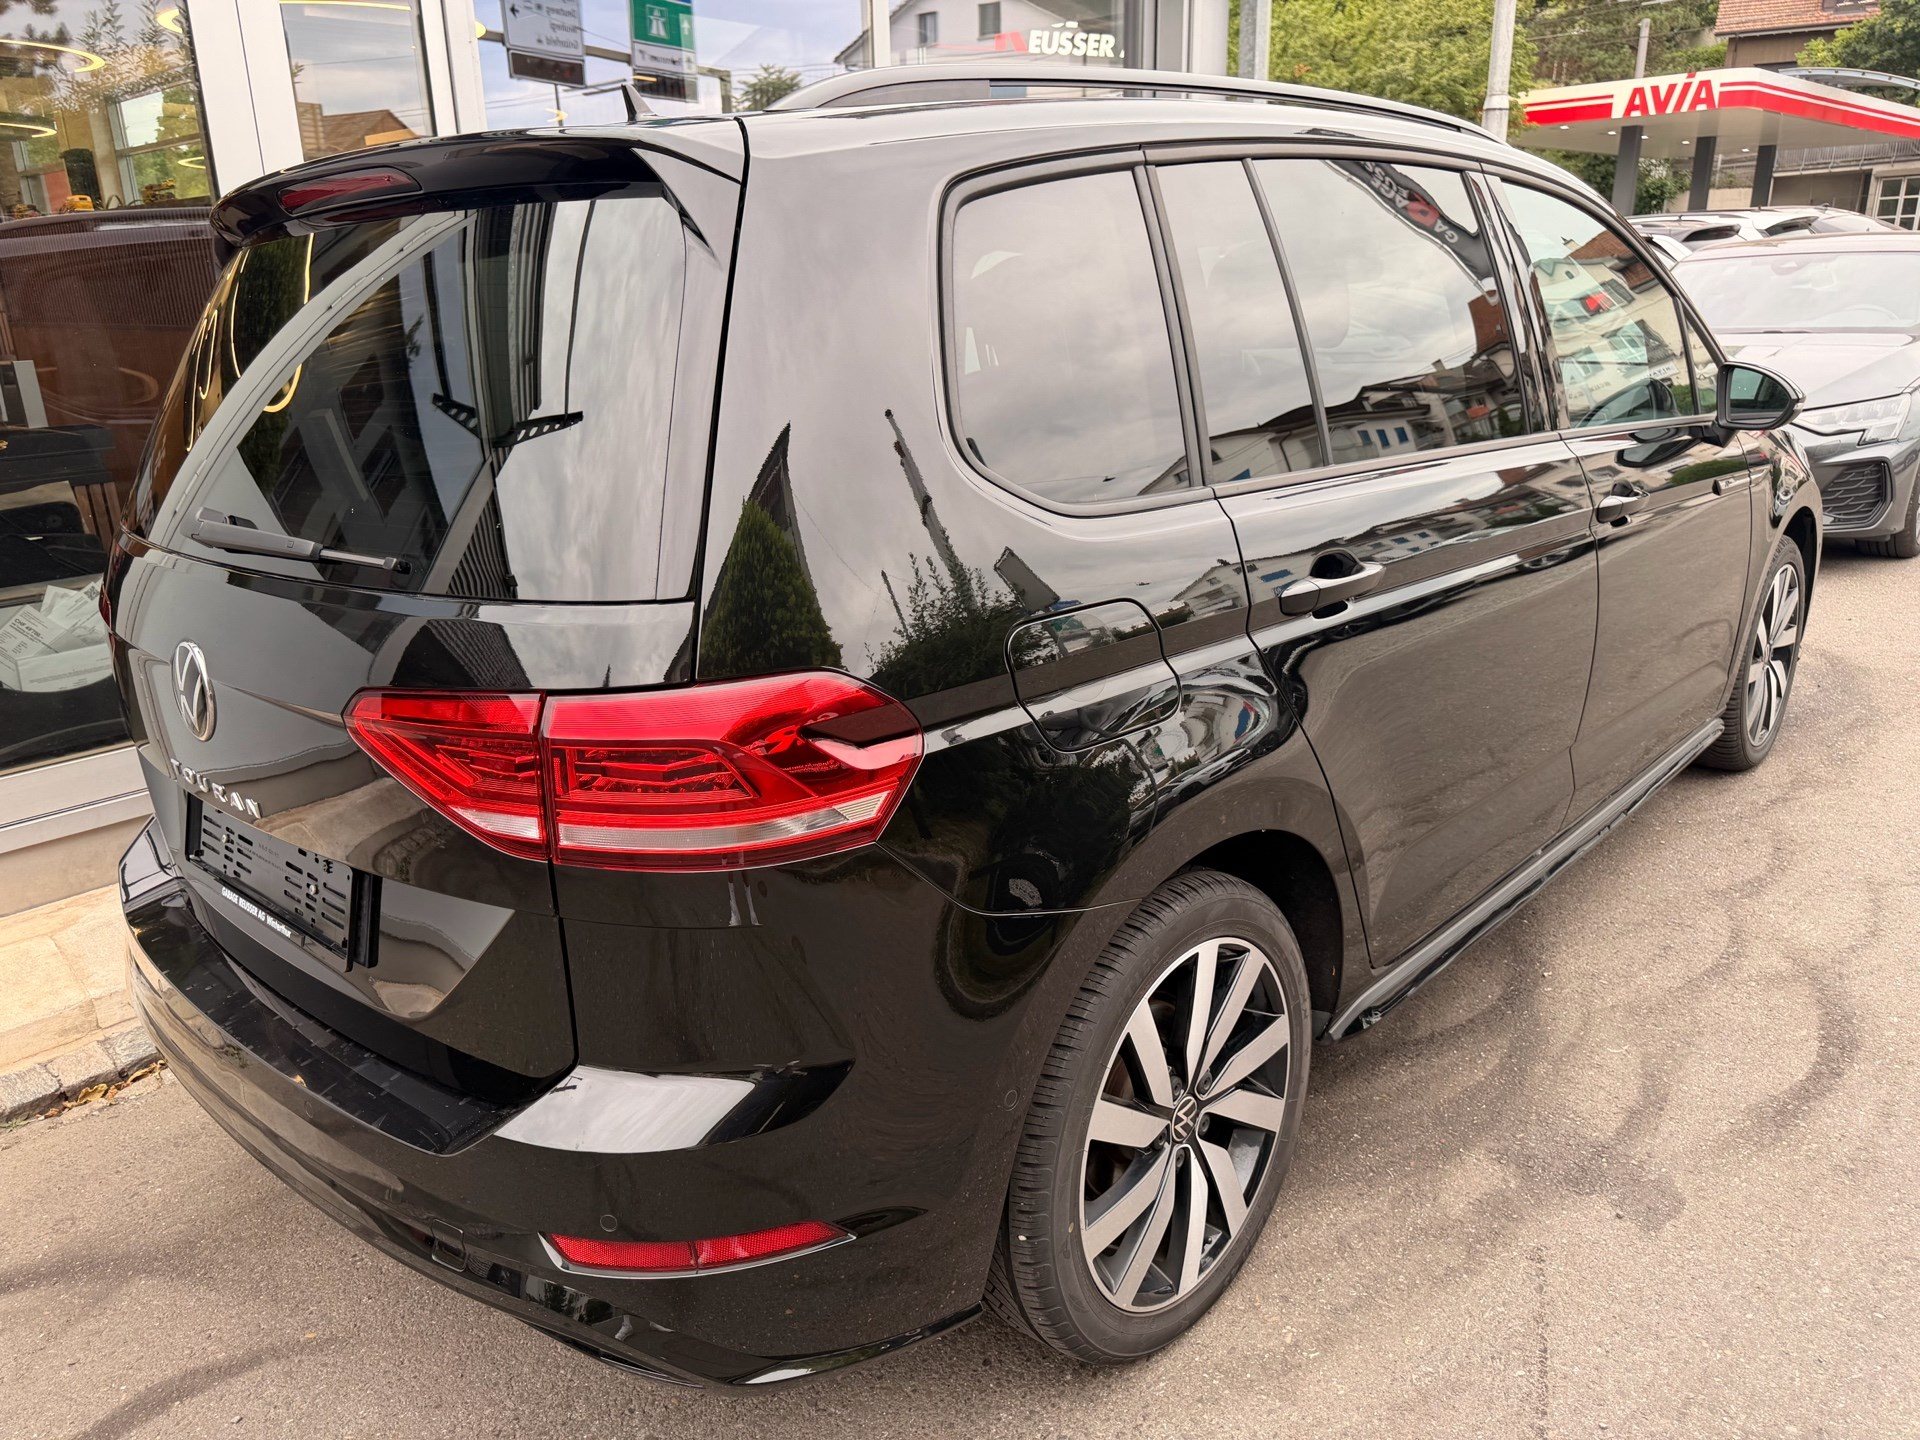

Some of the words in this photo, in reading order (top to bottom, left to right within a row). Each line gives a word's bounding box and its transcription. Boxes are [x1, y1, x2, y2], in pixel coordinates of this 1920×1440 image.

[1622, 72, 1717, 118] AVIA
[170, 758, 263, 820] TOURAN
[221, 886, 239, 905] GARAGE
[238, 897, 258, 917] REUSSER
[257, 909, 266, 922] AG
[266, 914, 292, 939] Winterthur
